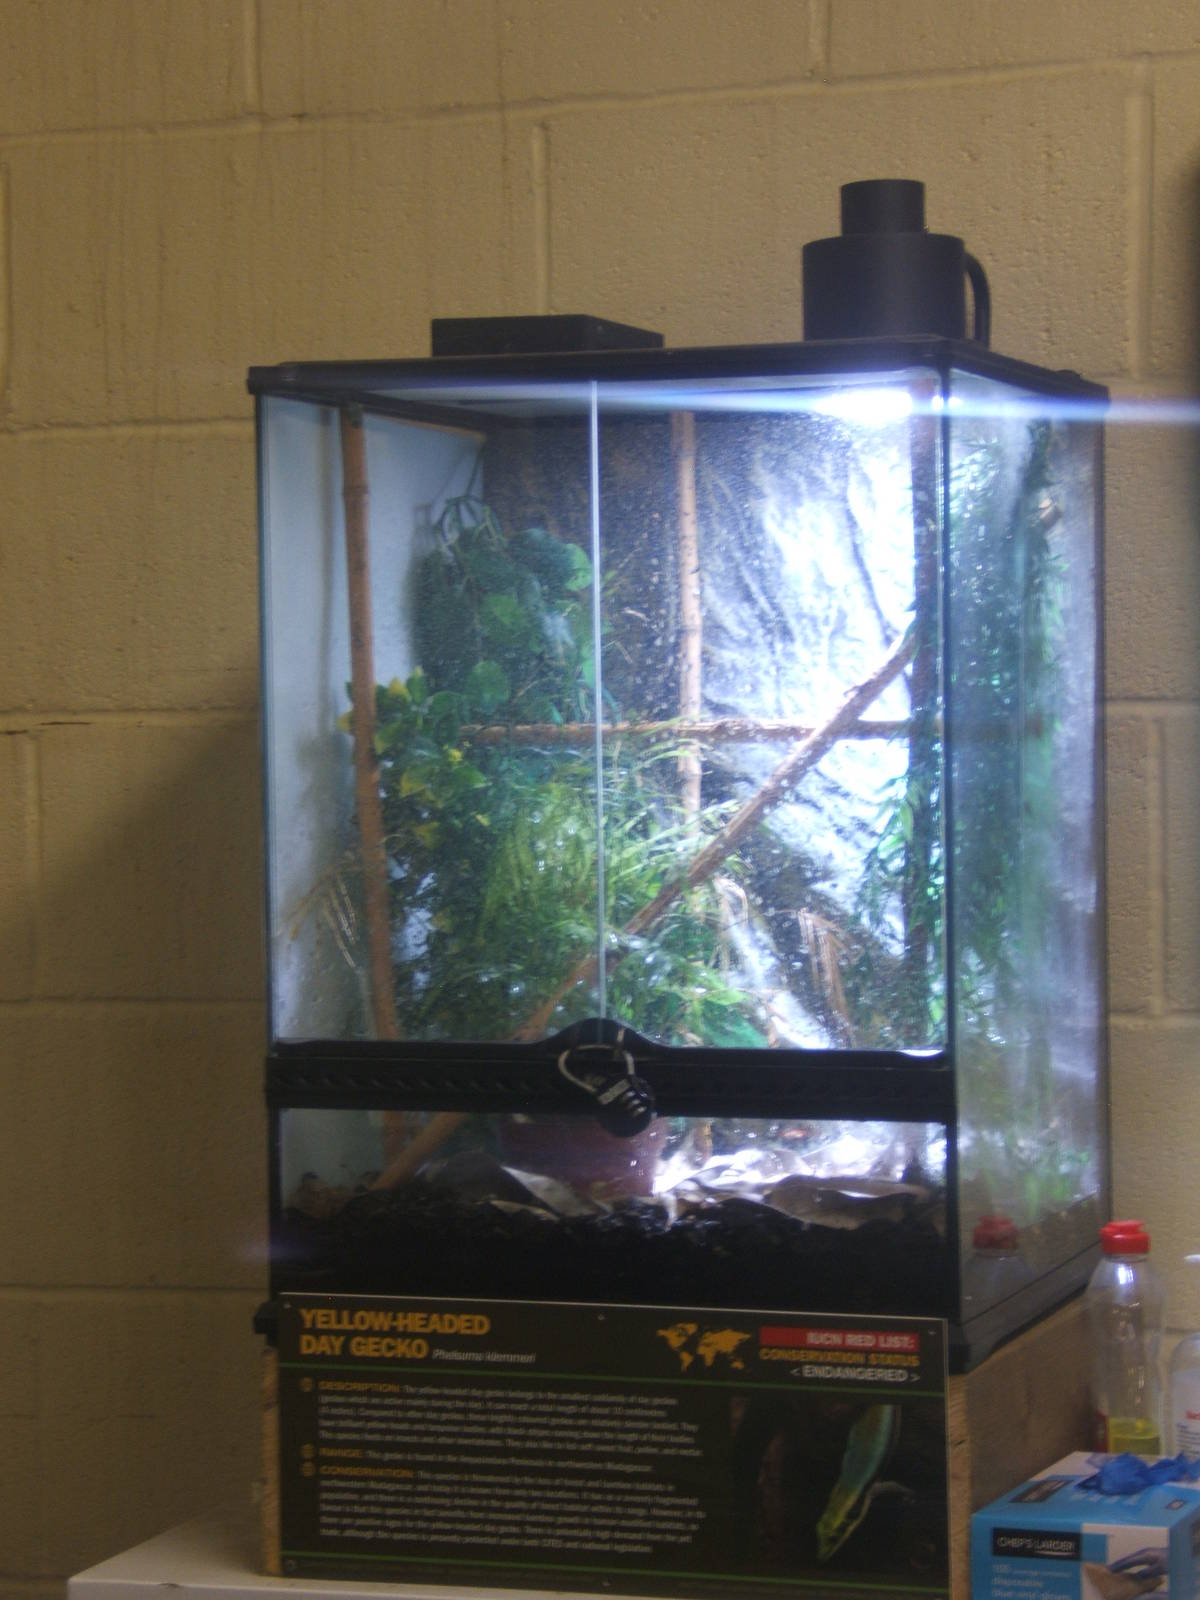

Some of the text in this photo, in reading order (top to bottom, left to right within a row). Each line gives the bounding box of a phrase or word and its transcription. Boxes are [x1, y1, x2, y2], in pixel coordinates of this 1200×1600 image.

[300, 1308, 490, 1335] YELLOW-HEADED
[300, 1335, 429, 1359] DAY GECKO
[845, 1333, 876, 1347] RED
